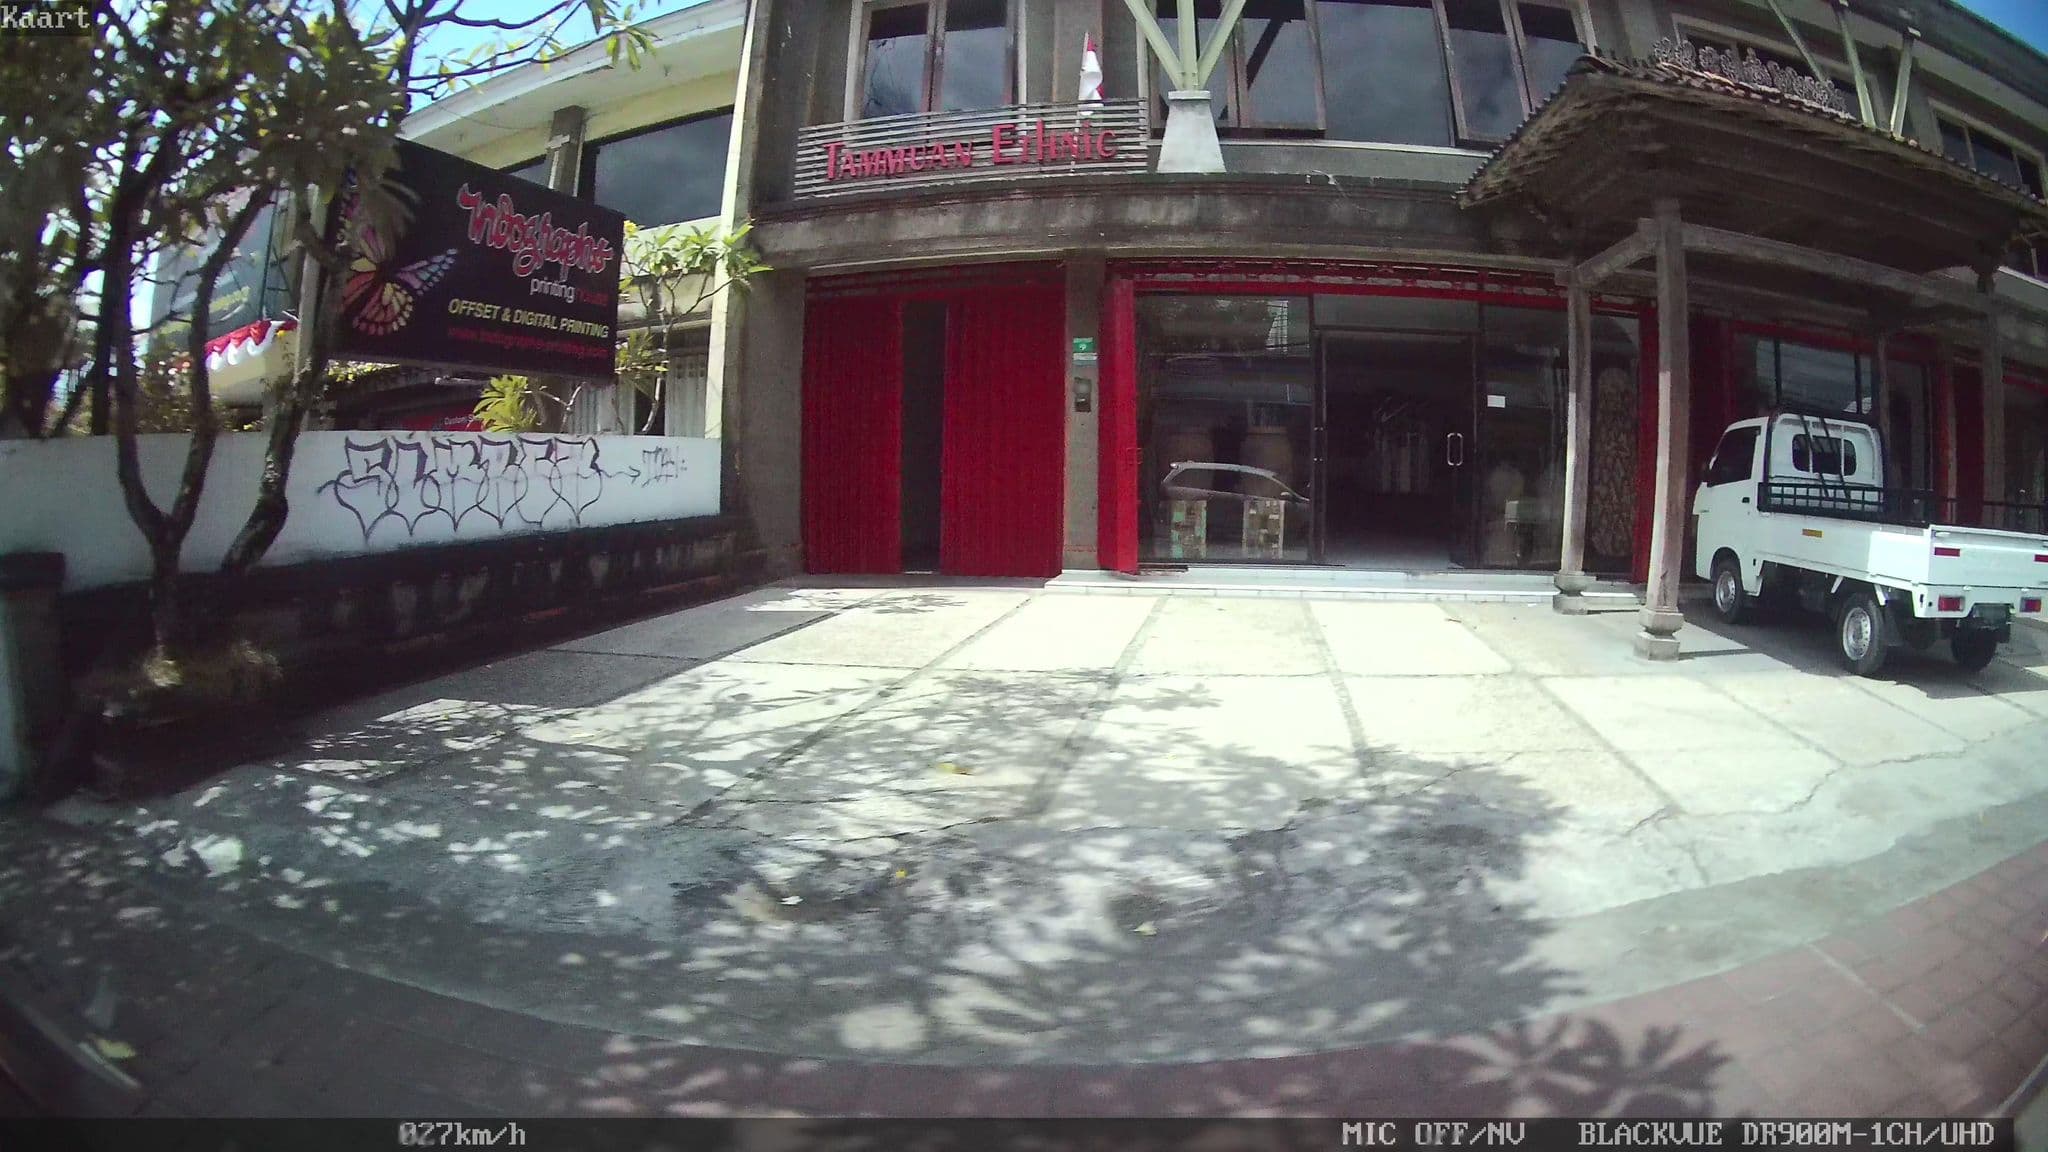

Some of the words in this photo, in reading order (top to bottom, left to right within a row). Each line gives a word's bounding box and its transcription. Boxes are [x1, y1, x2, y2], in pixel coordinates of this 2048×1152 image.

[530, 277, 575, 303] printing
[449, 298, 501, 318] OFFSET
[503, 308, 513, 322] &
[513, 309, 559, 330] DIGITAL
[560, 317, 610, 338] PRINTING
